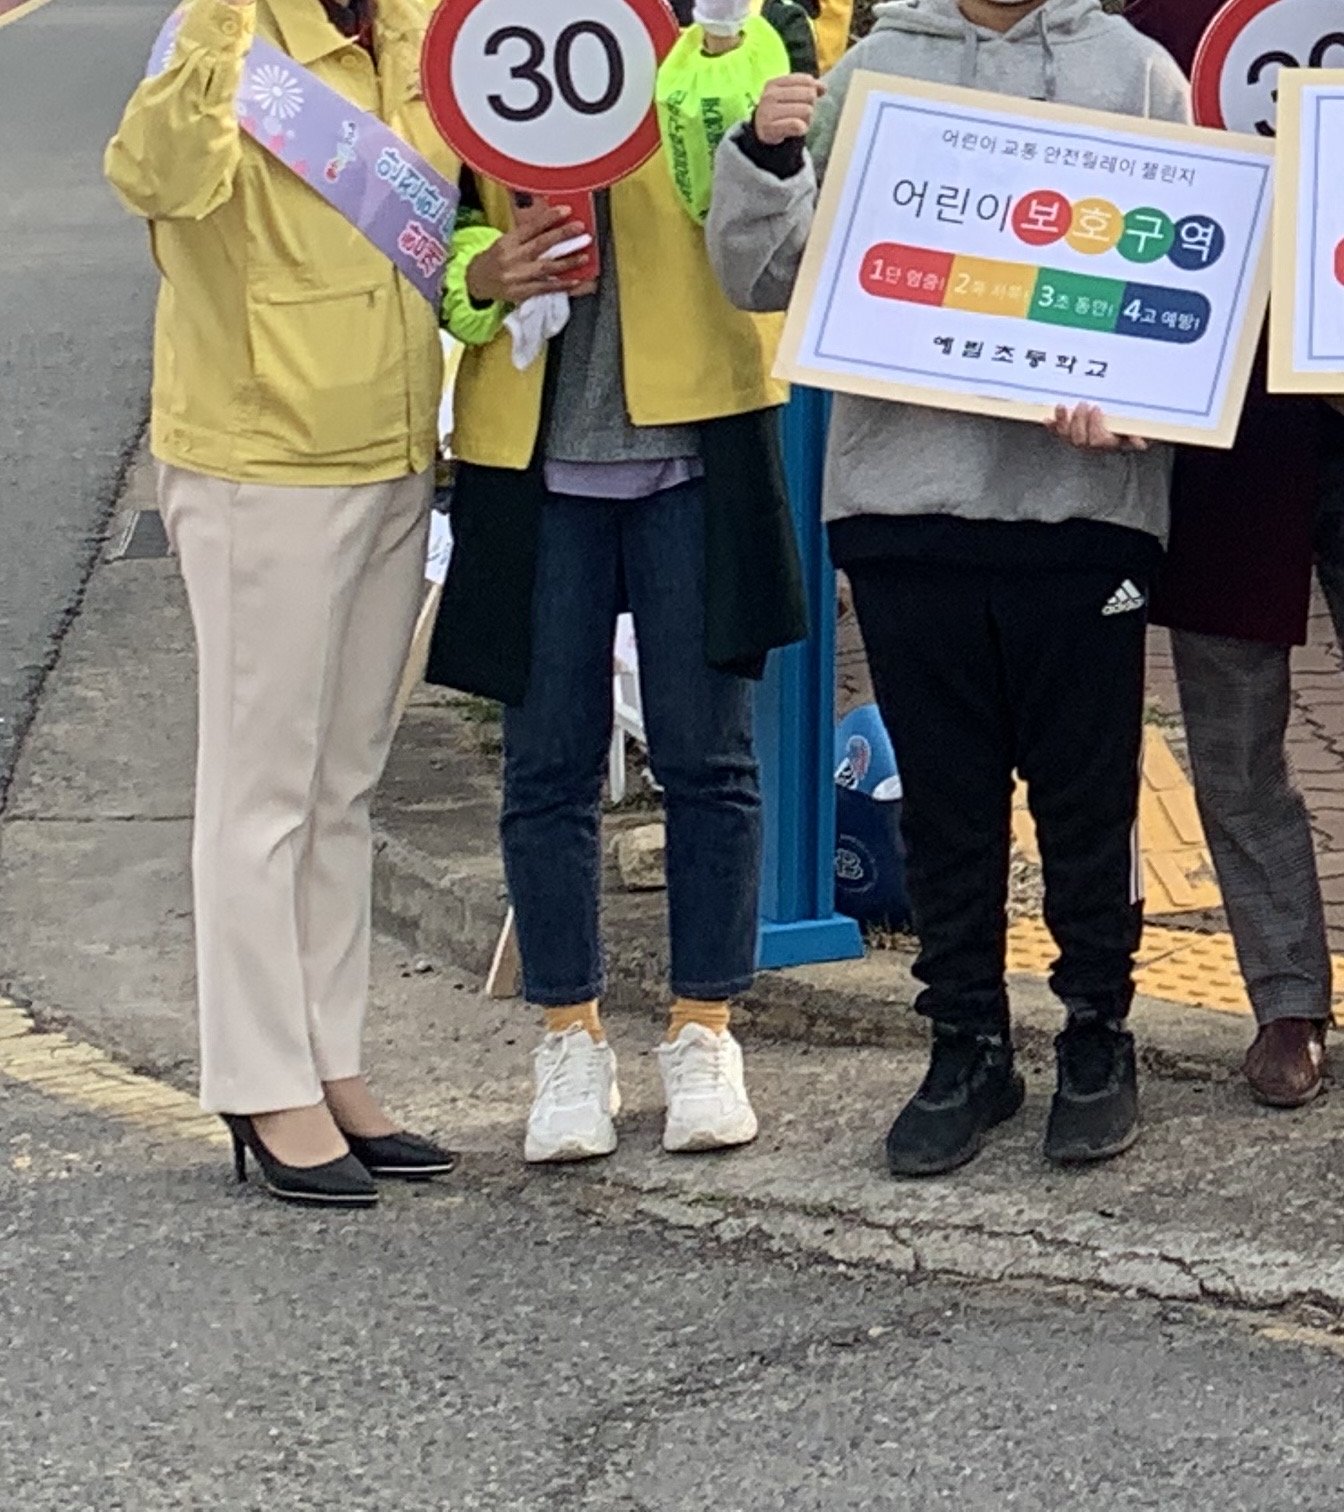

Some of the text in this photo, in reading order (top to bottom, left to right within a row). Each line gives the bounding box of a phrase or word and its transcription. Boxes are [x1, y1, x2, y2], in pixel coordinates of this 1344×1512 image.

[483, 19, 626, 122] 30
[942, 129, 997, 153] 어린이
[1001, 139, 1038, 161] 교통
[1141, 160, 1196, 188] 챌린지
[892, 177, 1214, 262] 어린이보호구역
